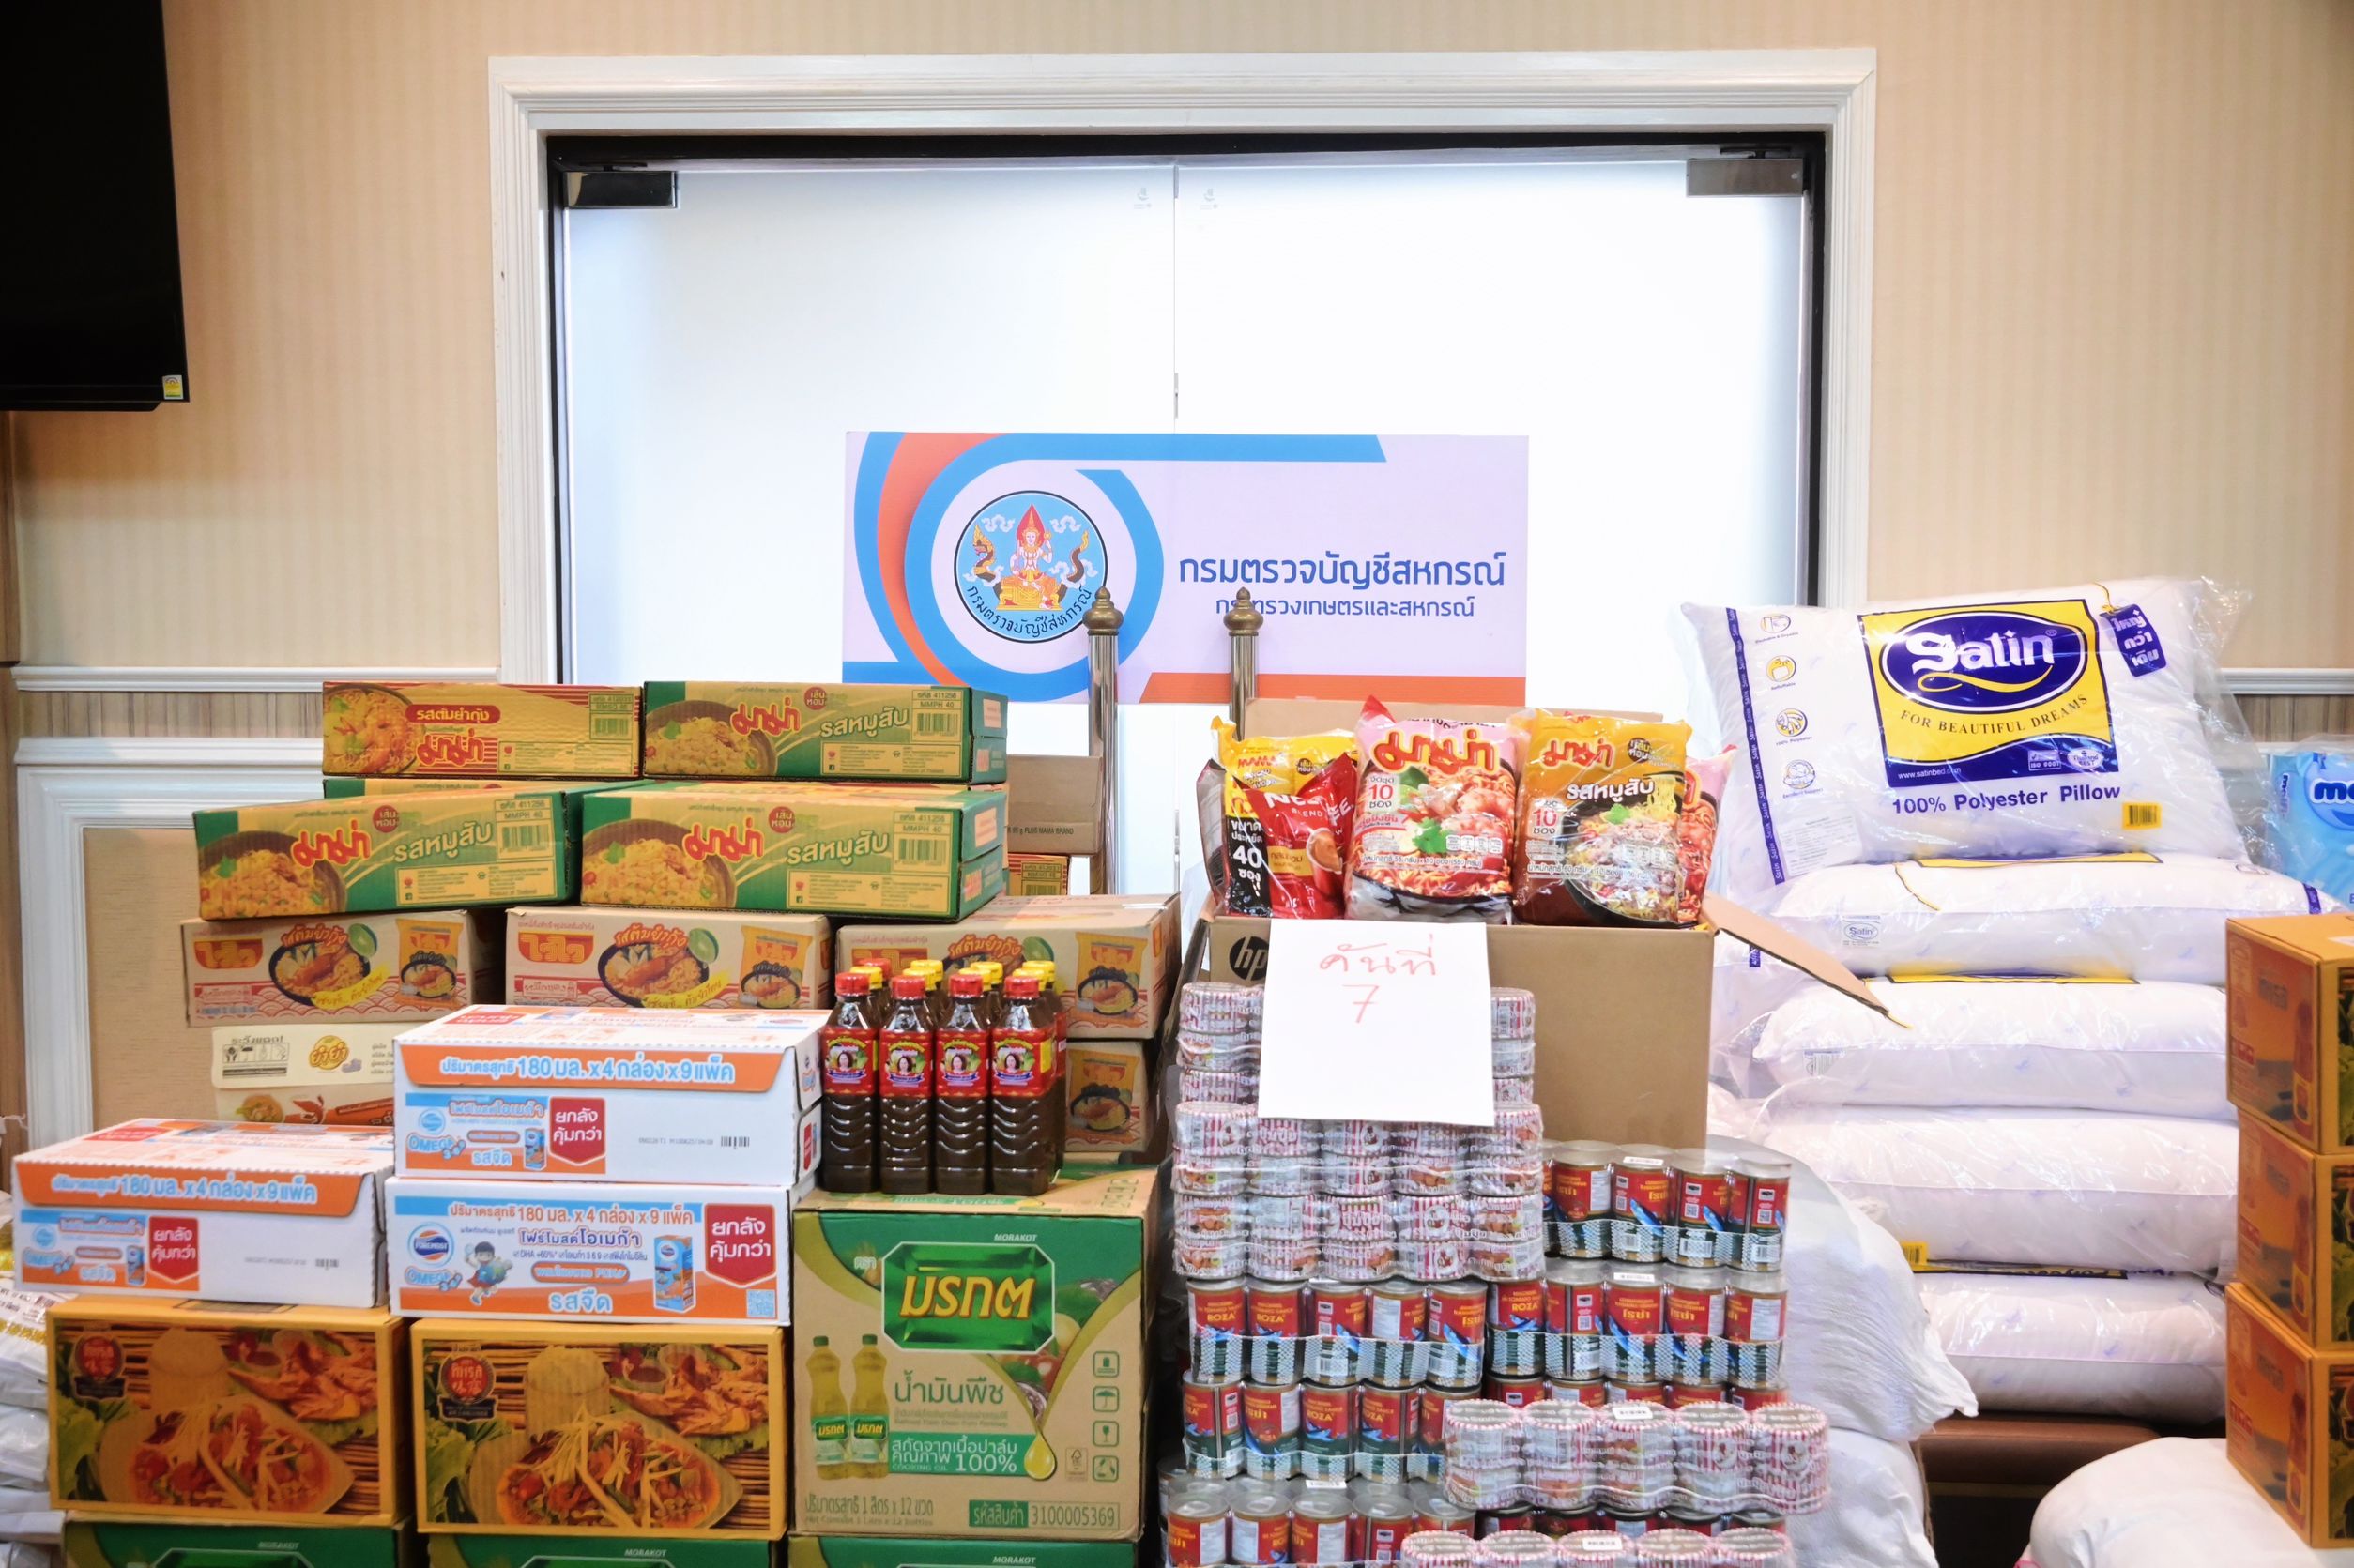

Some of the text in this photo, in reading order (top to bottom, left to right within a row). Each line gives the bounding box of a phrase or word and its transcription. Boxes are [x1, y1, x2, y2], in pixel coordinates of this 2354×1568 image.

[1179, 550, 1507, 590] กรมตรวจบัญชีสหกรณ์
[967, 585, 1093, 638] กรมตรวจบัญชีสหกรณ์
[1215, 595, 1475, 617] กรทรวงเกษตรและสหกรณ์
[2113, 610, 2147, 630] ใหญ่
[2124, 631, 2153, 649] กว่า
[1904, 630, 2055, 675] Satin
[2131, 647, 2160, 667] เดิม
[416, 708, 491, 724] รสต้มยำกุ้ง
[729, 698, 801, 736] มาม่า
[819, 706, 909, 737] รสหมูสับ
[1900, 693, 2088, 735] FOR BEAUTIFUL DREAMS
[416, 728, 485, 767] มาม่า
[1373, 729, 1496, 775] มาม่า
[1540, 738, 1614, 770] มาม่า
[1368, 784, 1394, 800] 10
[1566, 779, 1656, 803] รสหมูสับ
[1891, 784, 2121, 814] 100% Polyester Pillow
[1291, 808, 1323, 817] BLEND
[1368, 800, 1392, 809] ซอง
[1230, 820, 1262, 832] ขนาด
[1532, 809, 1558, 828] 10
[392, 822, 494, 862] รสหมูสับ
[682, 816, 765, 862] มาม่า
[1532, 827, 1556, 835] ซอง
[291, 818, 372, 868] มาม่า
[787, 830, 889, 865] รสหมูสับ
[1232, 845, 1262, 869] 40
[1238, 868, 1261, 882] ซอง
[615, 924, 688, 948] รสต้มยำกุ้ง
[1849, 926, 1873, 936] Satin
[948, 935, 1022, 956] รสต้มยำกุ้ง
[1318, 934, 1437, 977] คันที่
[1234, 939, 1268, 977] hp
[1341, 983, 1382, 1025] 7
[442, 1058, 515, 1078] ปริมาตรสุทธิ
[518, 1058, 551, 1076] 180
[555, 1059, 586, 1078] มล.
[615, 1052, 664, 1080] กล่อง
[695, 1055, 735, 1082] แพ็ค
[556, 1106, 598, 1124] ยกลัง
[553, 1125, 603, 1147] คุ้มกว่า
[472, 1148, 512, 1165] รสจืด
[120, 1176, 150, 1195] 180
[154, 1179, 183, 1196] มล.
[209, 1171, 253, 1199] กล่อง
[281, 1176, 316, 1203] แพ็ค
[450, 1204, 515, 1222] ปริมาตรสุทธิ
[518, 1207, 544, 1222] 180
[547, 1209, 572, 1222] มล.
[586, 1210, 595, 1222] 4
[599, 1205, 635, 1224] กล่อง
[650, 1210, 659, 1224] 9
[663, 1203, 694, 1225] แพ็ค
[153, 1227, 193, 1242] ยกลัง
[520, 1228, 641, 1246] โฟร์โมสต์โอเมก้า
[711, 1215, 767, 1237] ยกลัง
[993, 1233, 1038, 1242] MORAKOT
[151, 1245, 196, 1264] คุ้มกว่า
[710, 1239, 772, 1266] คุ้มกว่า
[549, 1288, 612, 1313] รสจืด
[899, 1275, 1036, 1320] มรกต
[1511, 1302, 1538, 1312] ROZA
[1206, 1313, 1236, 1322] ROZA
[1256, 1313, 1285, 1323] ROZA
[894, 1370, 1004, 1405] น้ำมันพืช
[856, 1423, 883, 1435] มรกต
[892, 1435, 1017, 1454] สกัดจากเนื้อปาล์ม
[892, 1452, 1017, 1473] คุณภาพ 100%
[900, 1497, 913, 1515] 12
[973, 1500, 1116, 1527] รหัสสินค้า 3100005369
[624, 1548, 667, 1558] MORAKOT
[992, 1556, 1037, 1564] MORAKOT
